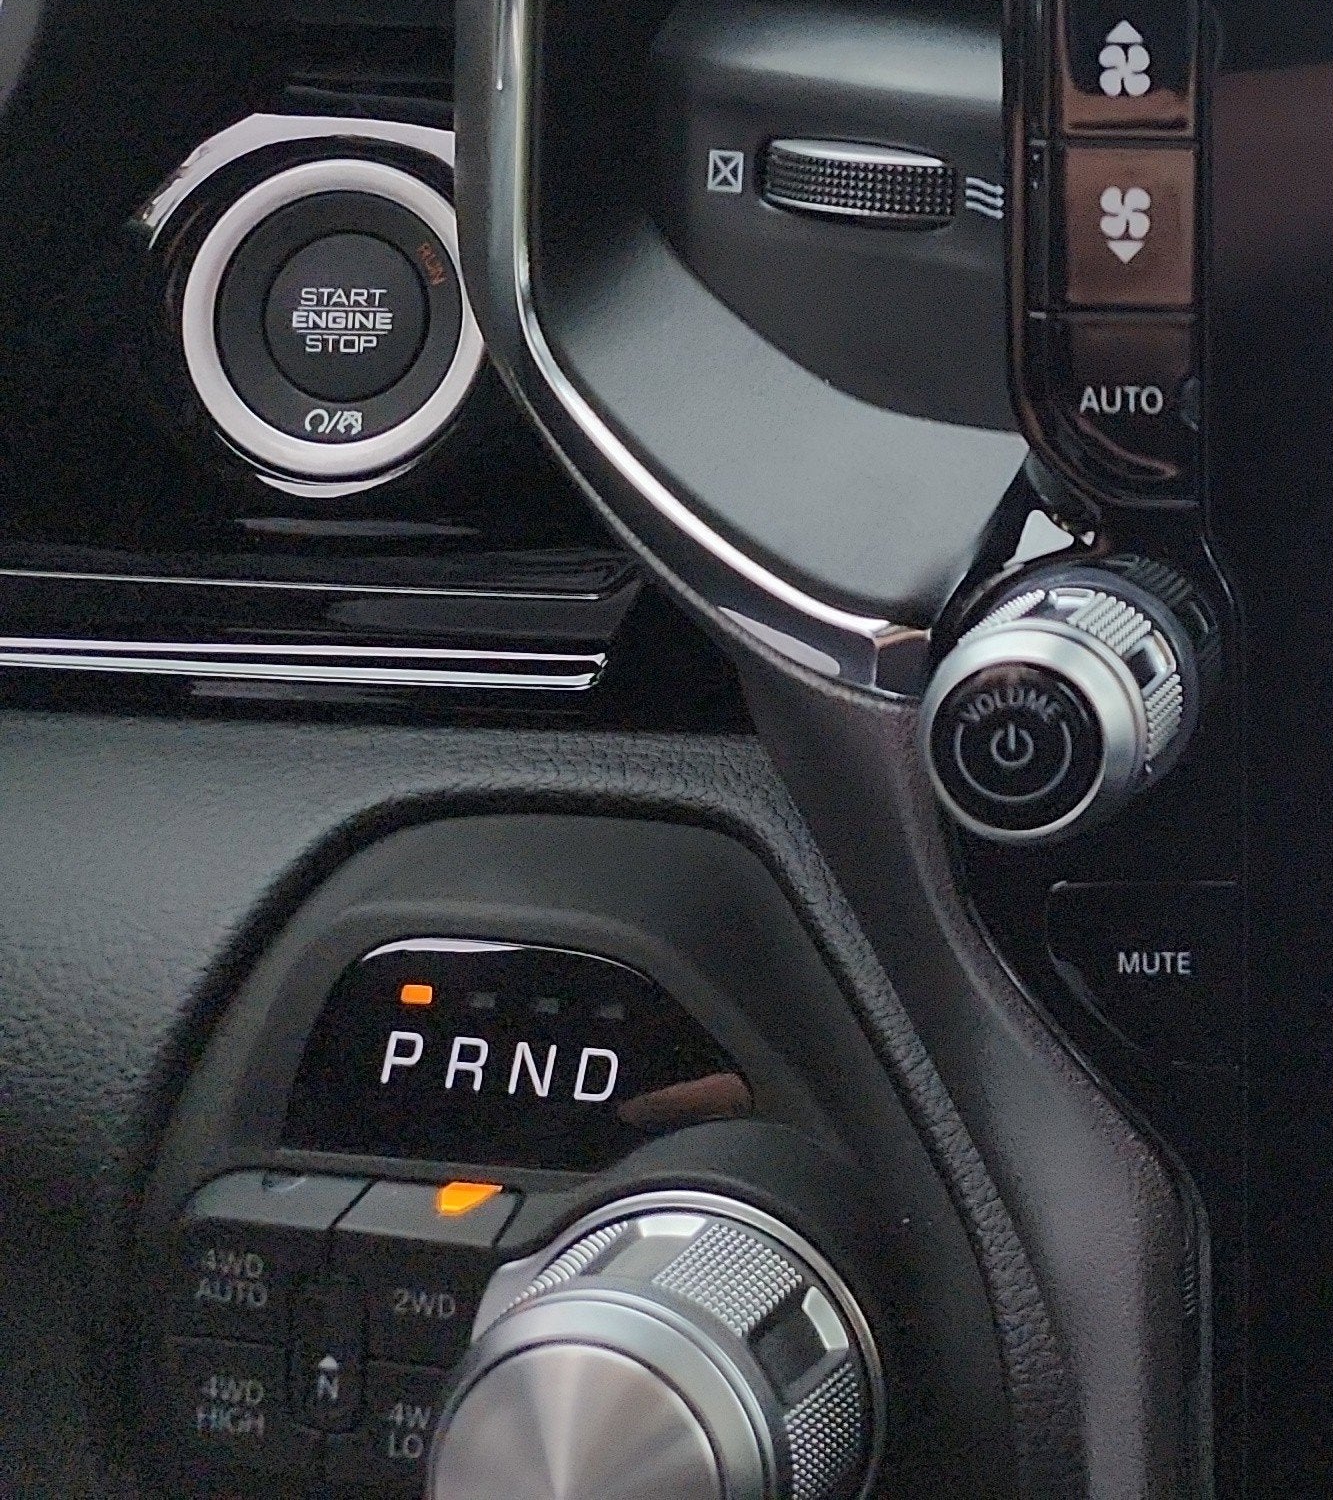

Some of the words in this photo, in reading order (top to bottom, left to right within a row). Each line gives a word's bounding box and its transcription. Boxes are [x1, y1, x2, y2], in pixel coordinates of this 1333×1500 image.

[300, 287, 388, 306] START
[292, 311, 393, 330] ENGINE
[304, 335, 377, 353] STOP
[1079, 386, 1164, 414] AUTO
[959, 684, 1062, 724] VOLUME
[1118, 951, 1191, 975] MUTE
[393, 1288, 457, 1319] 2WD
[388, 1402, 432, 1430] 4W
[388, 1431, 425, 1459] LO
